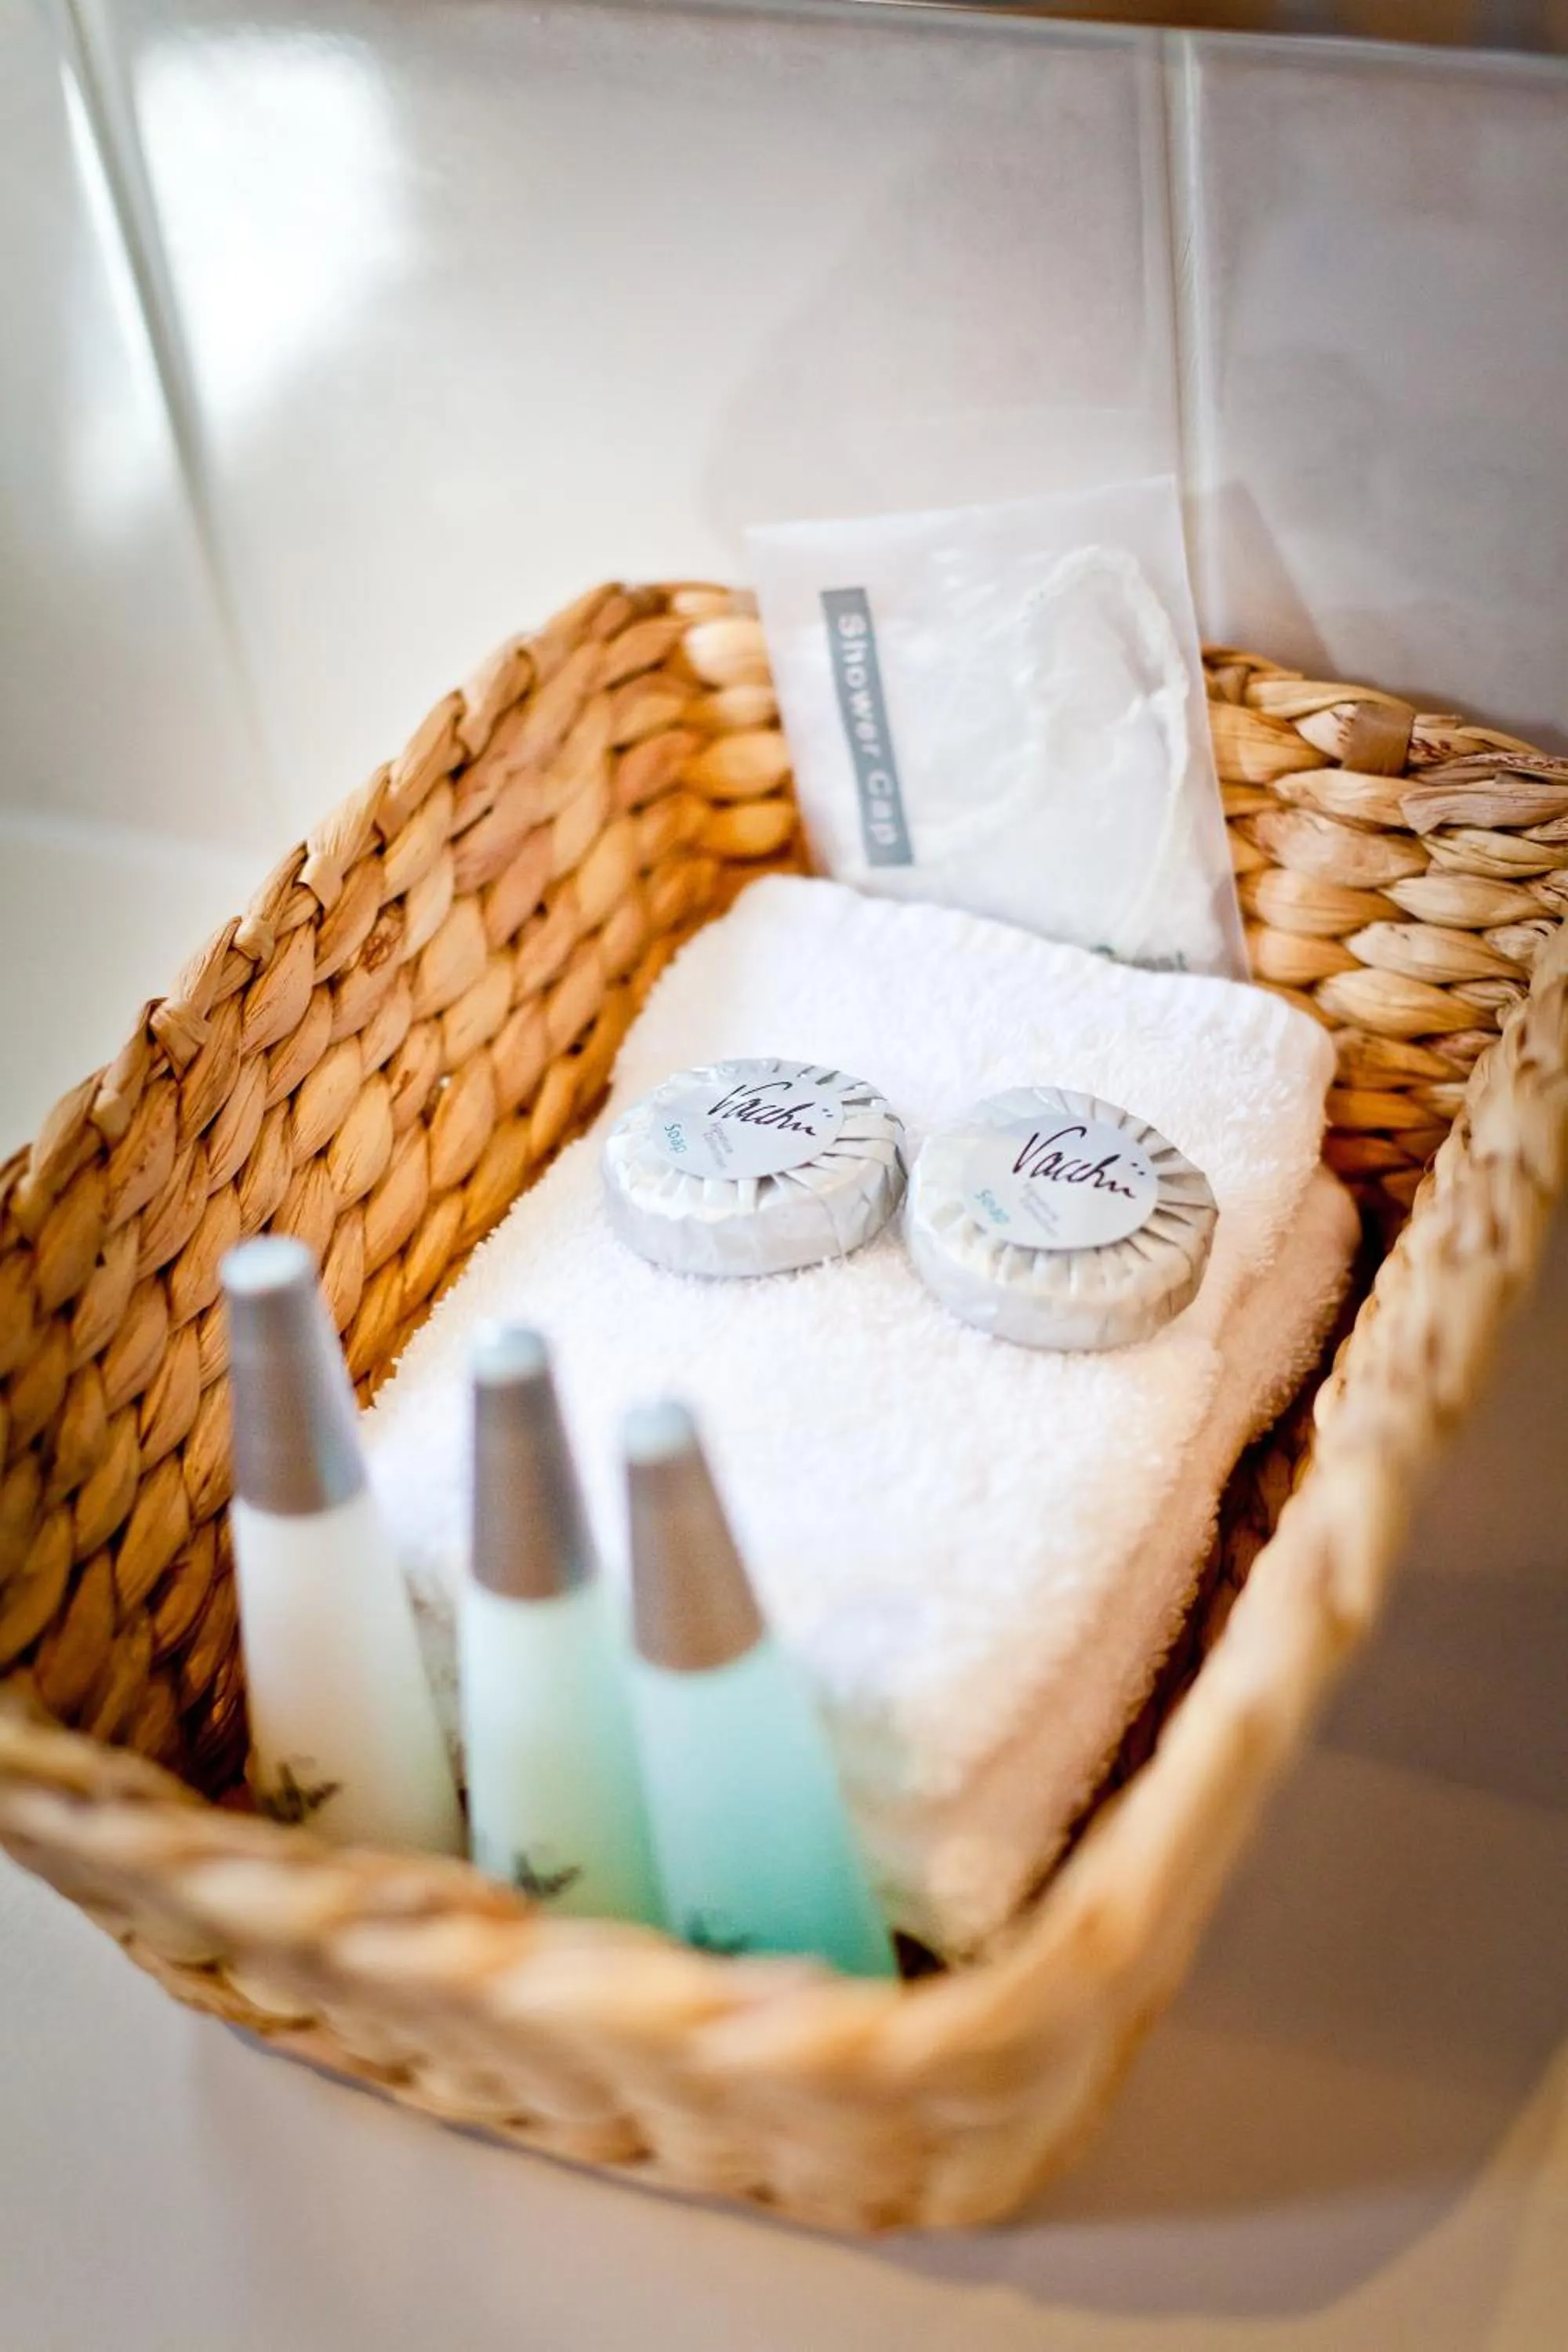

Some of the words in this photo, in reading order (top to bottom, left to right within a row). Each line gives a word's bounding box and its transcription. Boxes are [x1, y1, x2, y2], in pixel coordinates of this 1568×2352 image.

[837, 613, 881, 758] Shower
[868, 769, 898, 846] Cap
[663, 1123, 688, 1155] Soap
